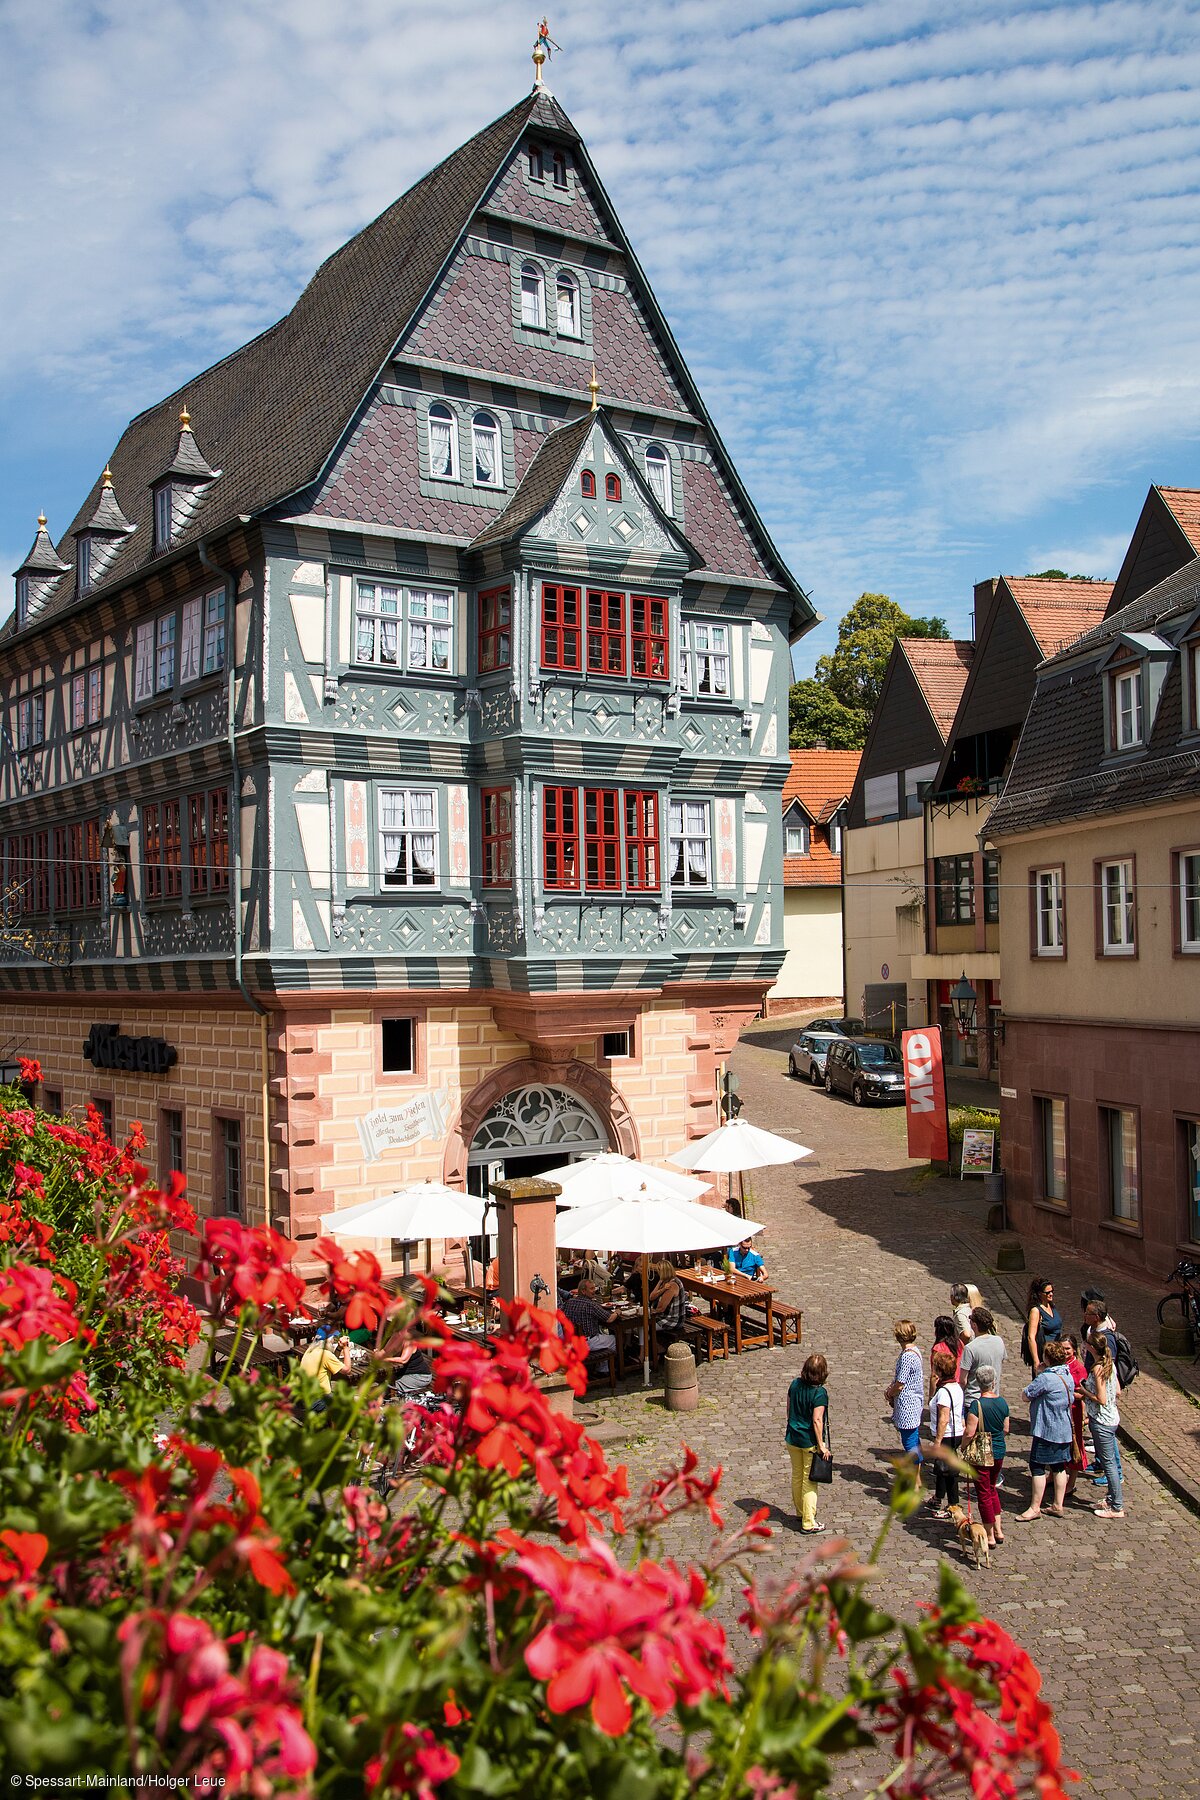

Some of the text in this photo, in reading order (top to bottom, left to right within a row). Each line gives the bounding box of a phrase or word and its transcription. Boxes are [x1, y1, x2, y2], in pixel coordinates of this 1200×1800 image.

[86, 1024, 172, 1073] Riesen
[369, 1112, 387, 1129] Hotel
[388, 1113, 404, 1124] zum
